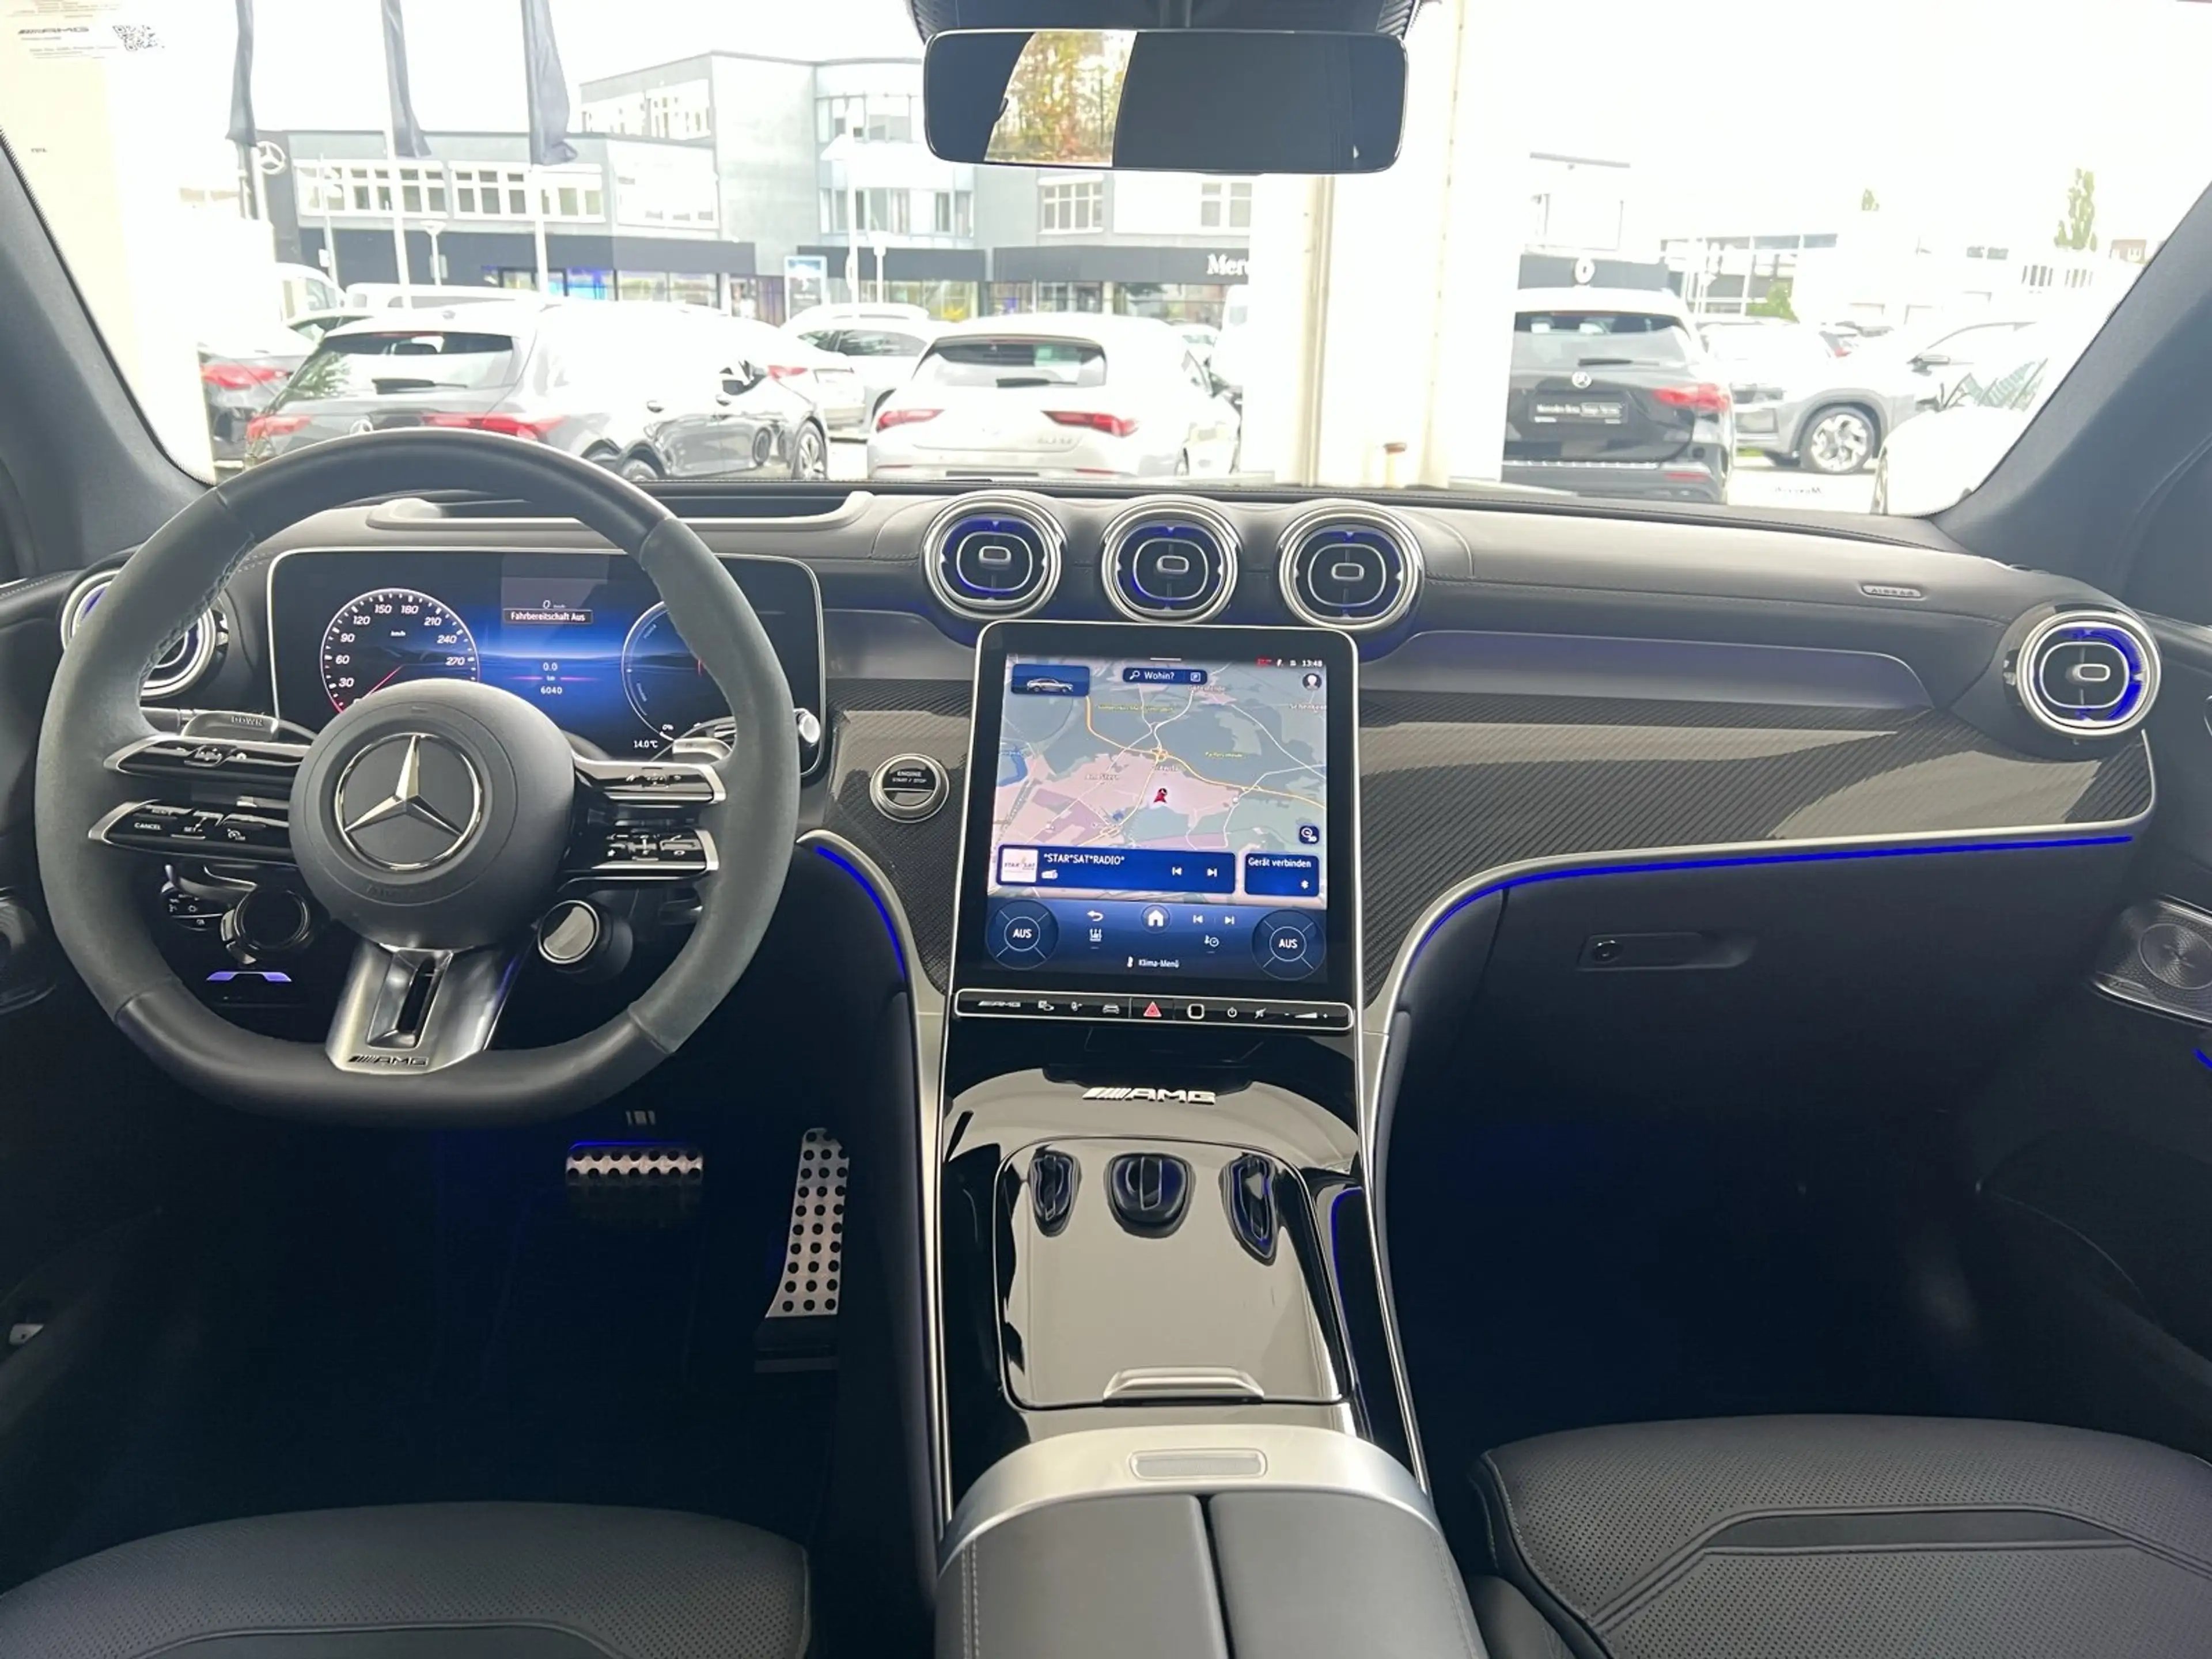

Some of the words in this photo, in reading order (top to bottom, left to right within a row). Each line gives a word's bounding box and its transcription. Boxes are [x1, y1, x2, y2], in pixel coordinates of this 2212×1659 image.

[374, 604, 392, 614] 150
[543, 600, 551, 609] 0
[401, 605, 419, 615] 180
[353, 615, 370, 625] 120
[424, 616, 442, 627] 210
[511, 611, 569, 620] Fahrbereitschaft
[571, 613, 586, 622] Aus
[340, 633, 355, 643] 90
[437, 635, 457, 644] 240
[336, 654, 350, 664] 60
[445, 657, 465, 666] 270
[543, 662, 558, 671] 0.0
[1144, 672, 1175, 680] Wohin?
[339, 677, 354, 687] 30
[540, 685, 563, 694] 6040
[134, 823, 162, 831] CANCEL
[1248, 857, 1270, 867] Gerät
[1272, 859, 1312, 868] verbinden
[1013, 928, 1032, 940] AUS
[1278, 938, 1298, 949] AUS
[374, 1055, 430, 1066] AMG
[1125, 1088, 1216, 1105] AMG
